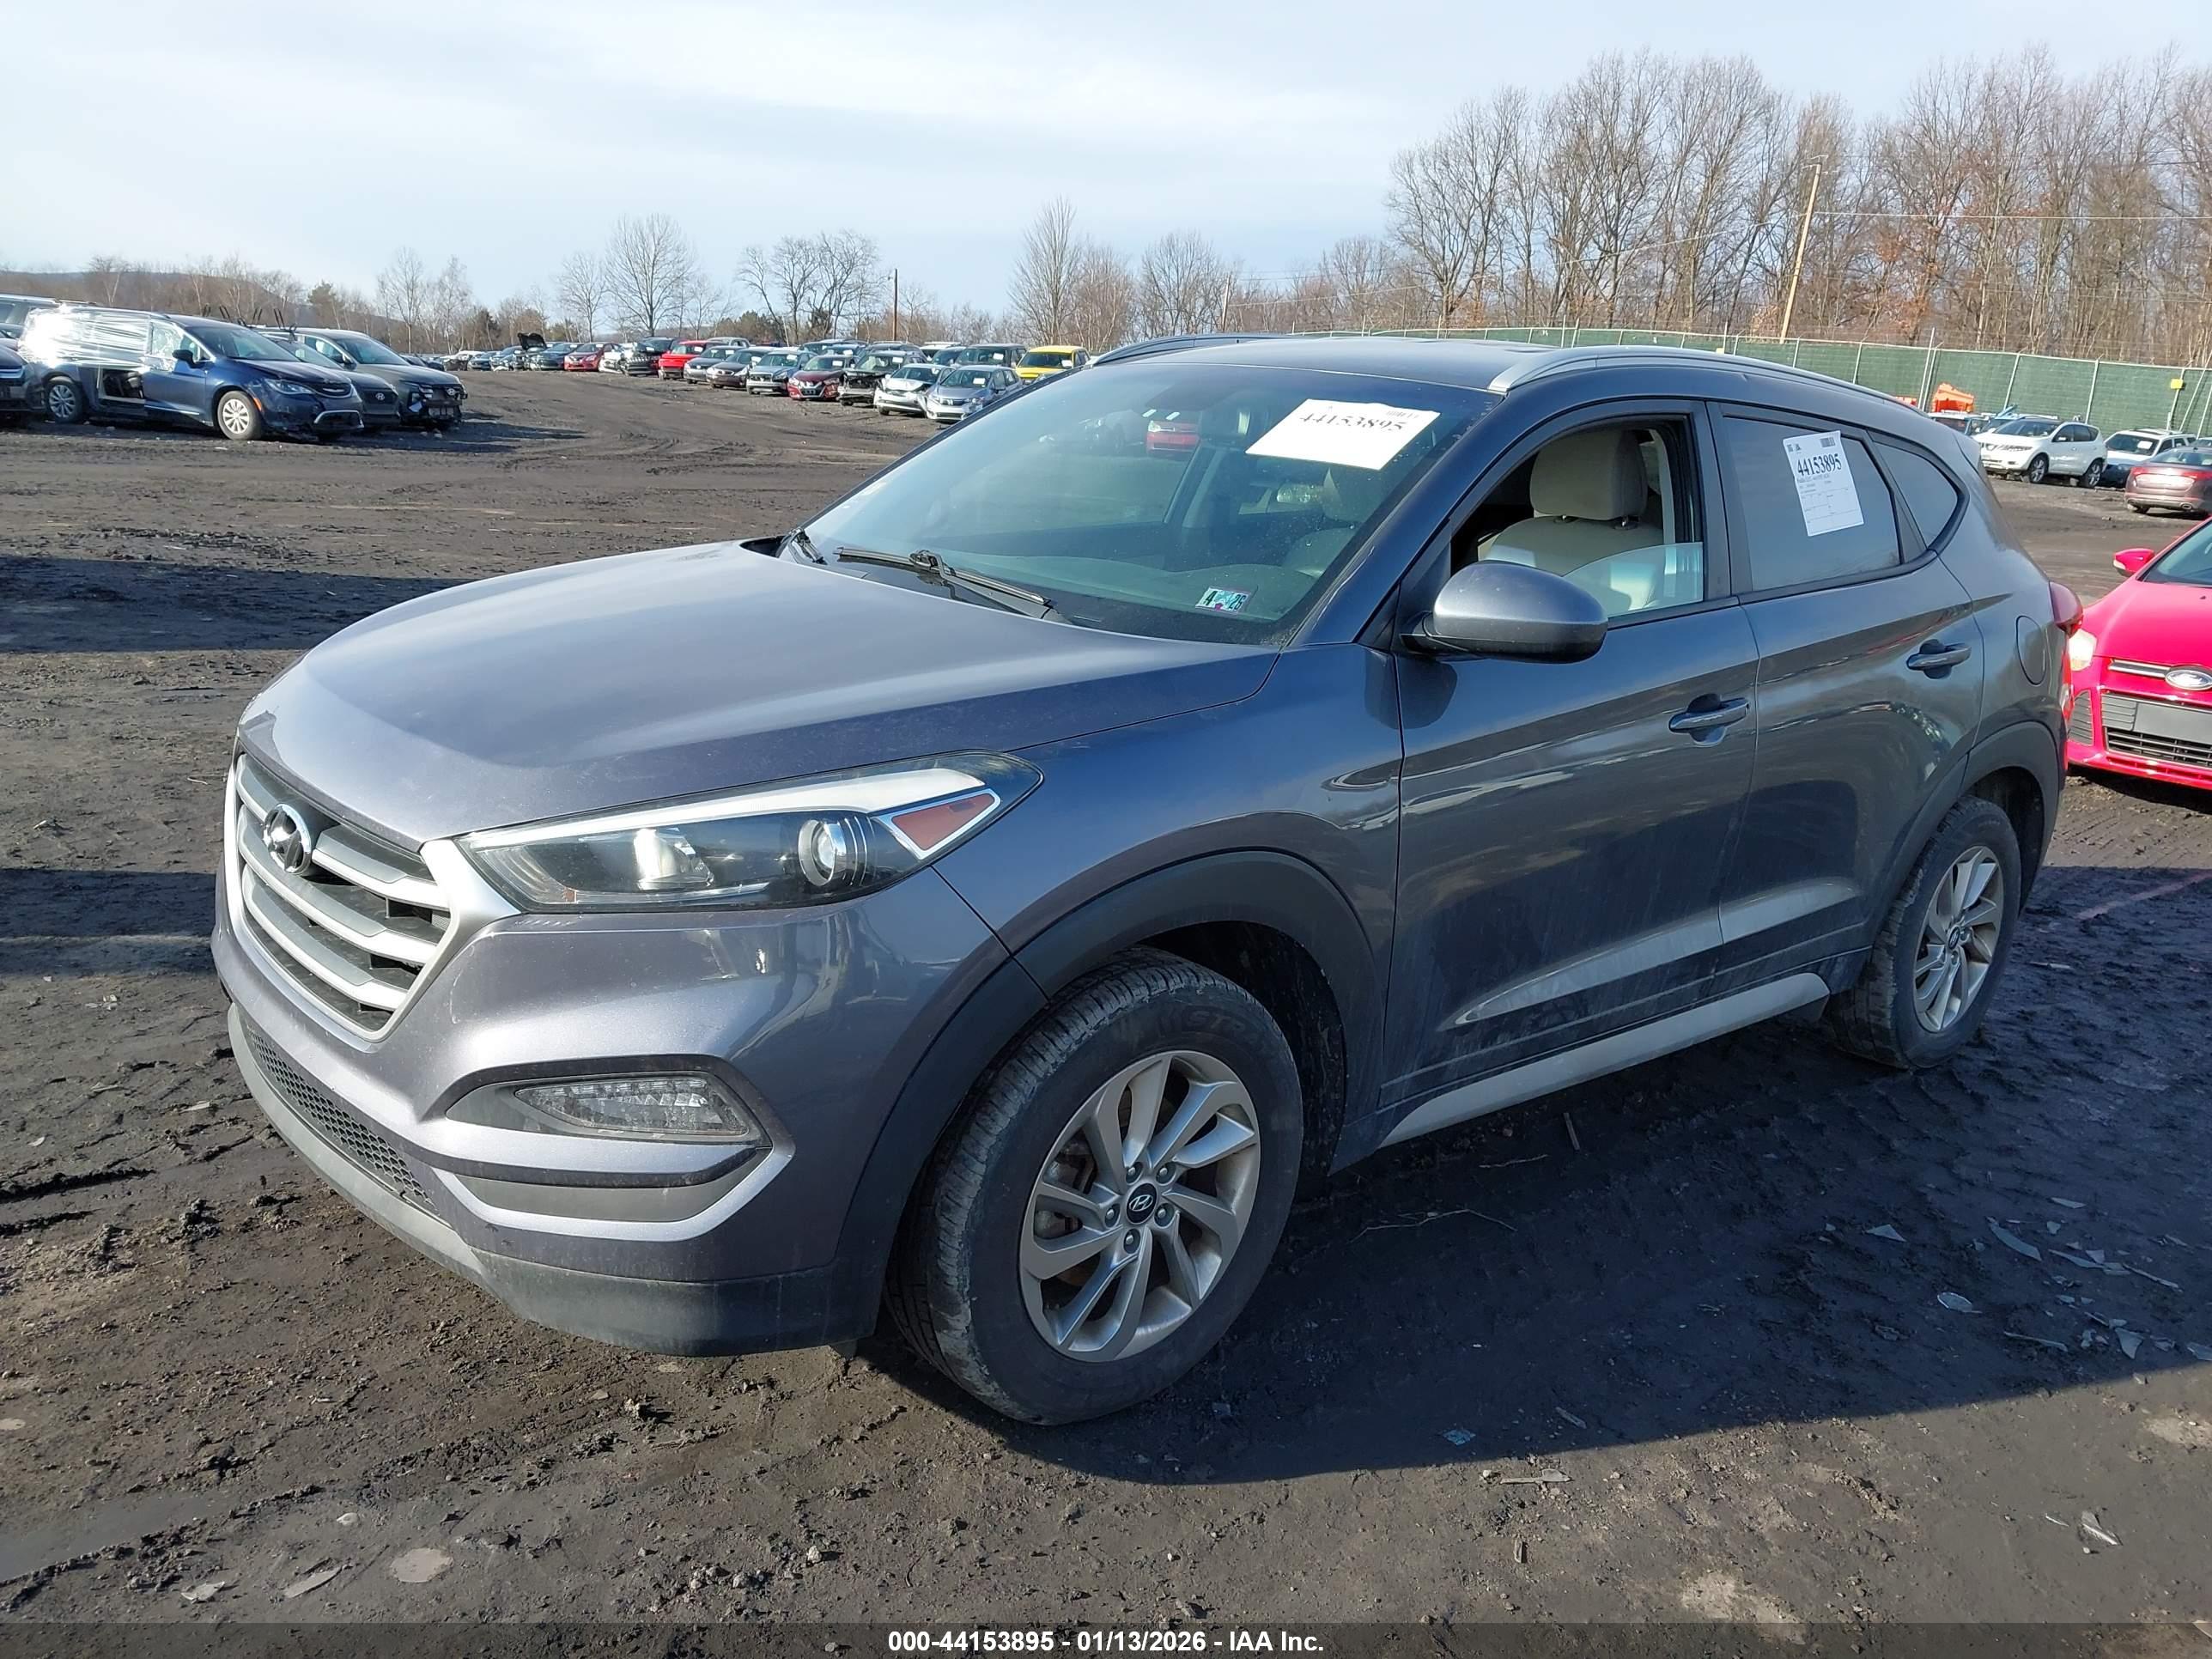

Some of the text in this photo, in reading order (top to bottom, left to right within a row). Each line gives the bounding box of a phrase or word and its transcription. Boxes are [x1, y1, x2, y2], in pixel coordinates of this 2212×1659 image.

[1299, 412, 1407, 431] 44153895
[1797, 453, 1842, 477] 44153895
[1203, 590, 1247, 611] 4 26
